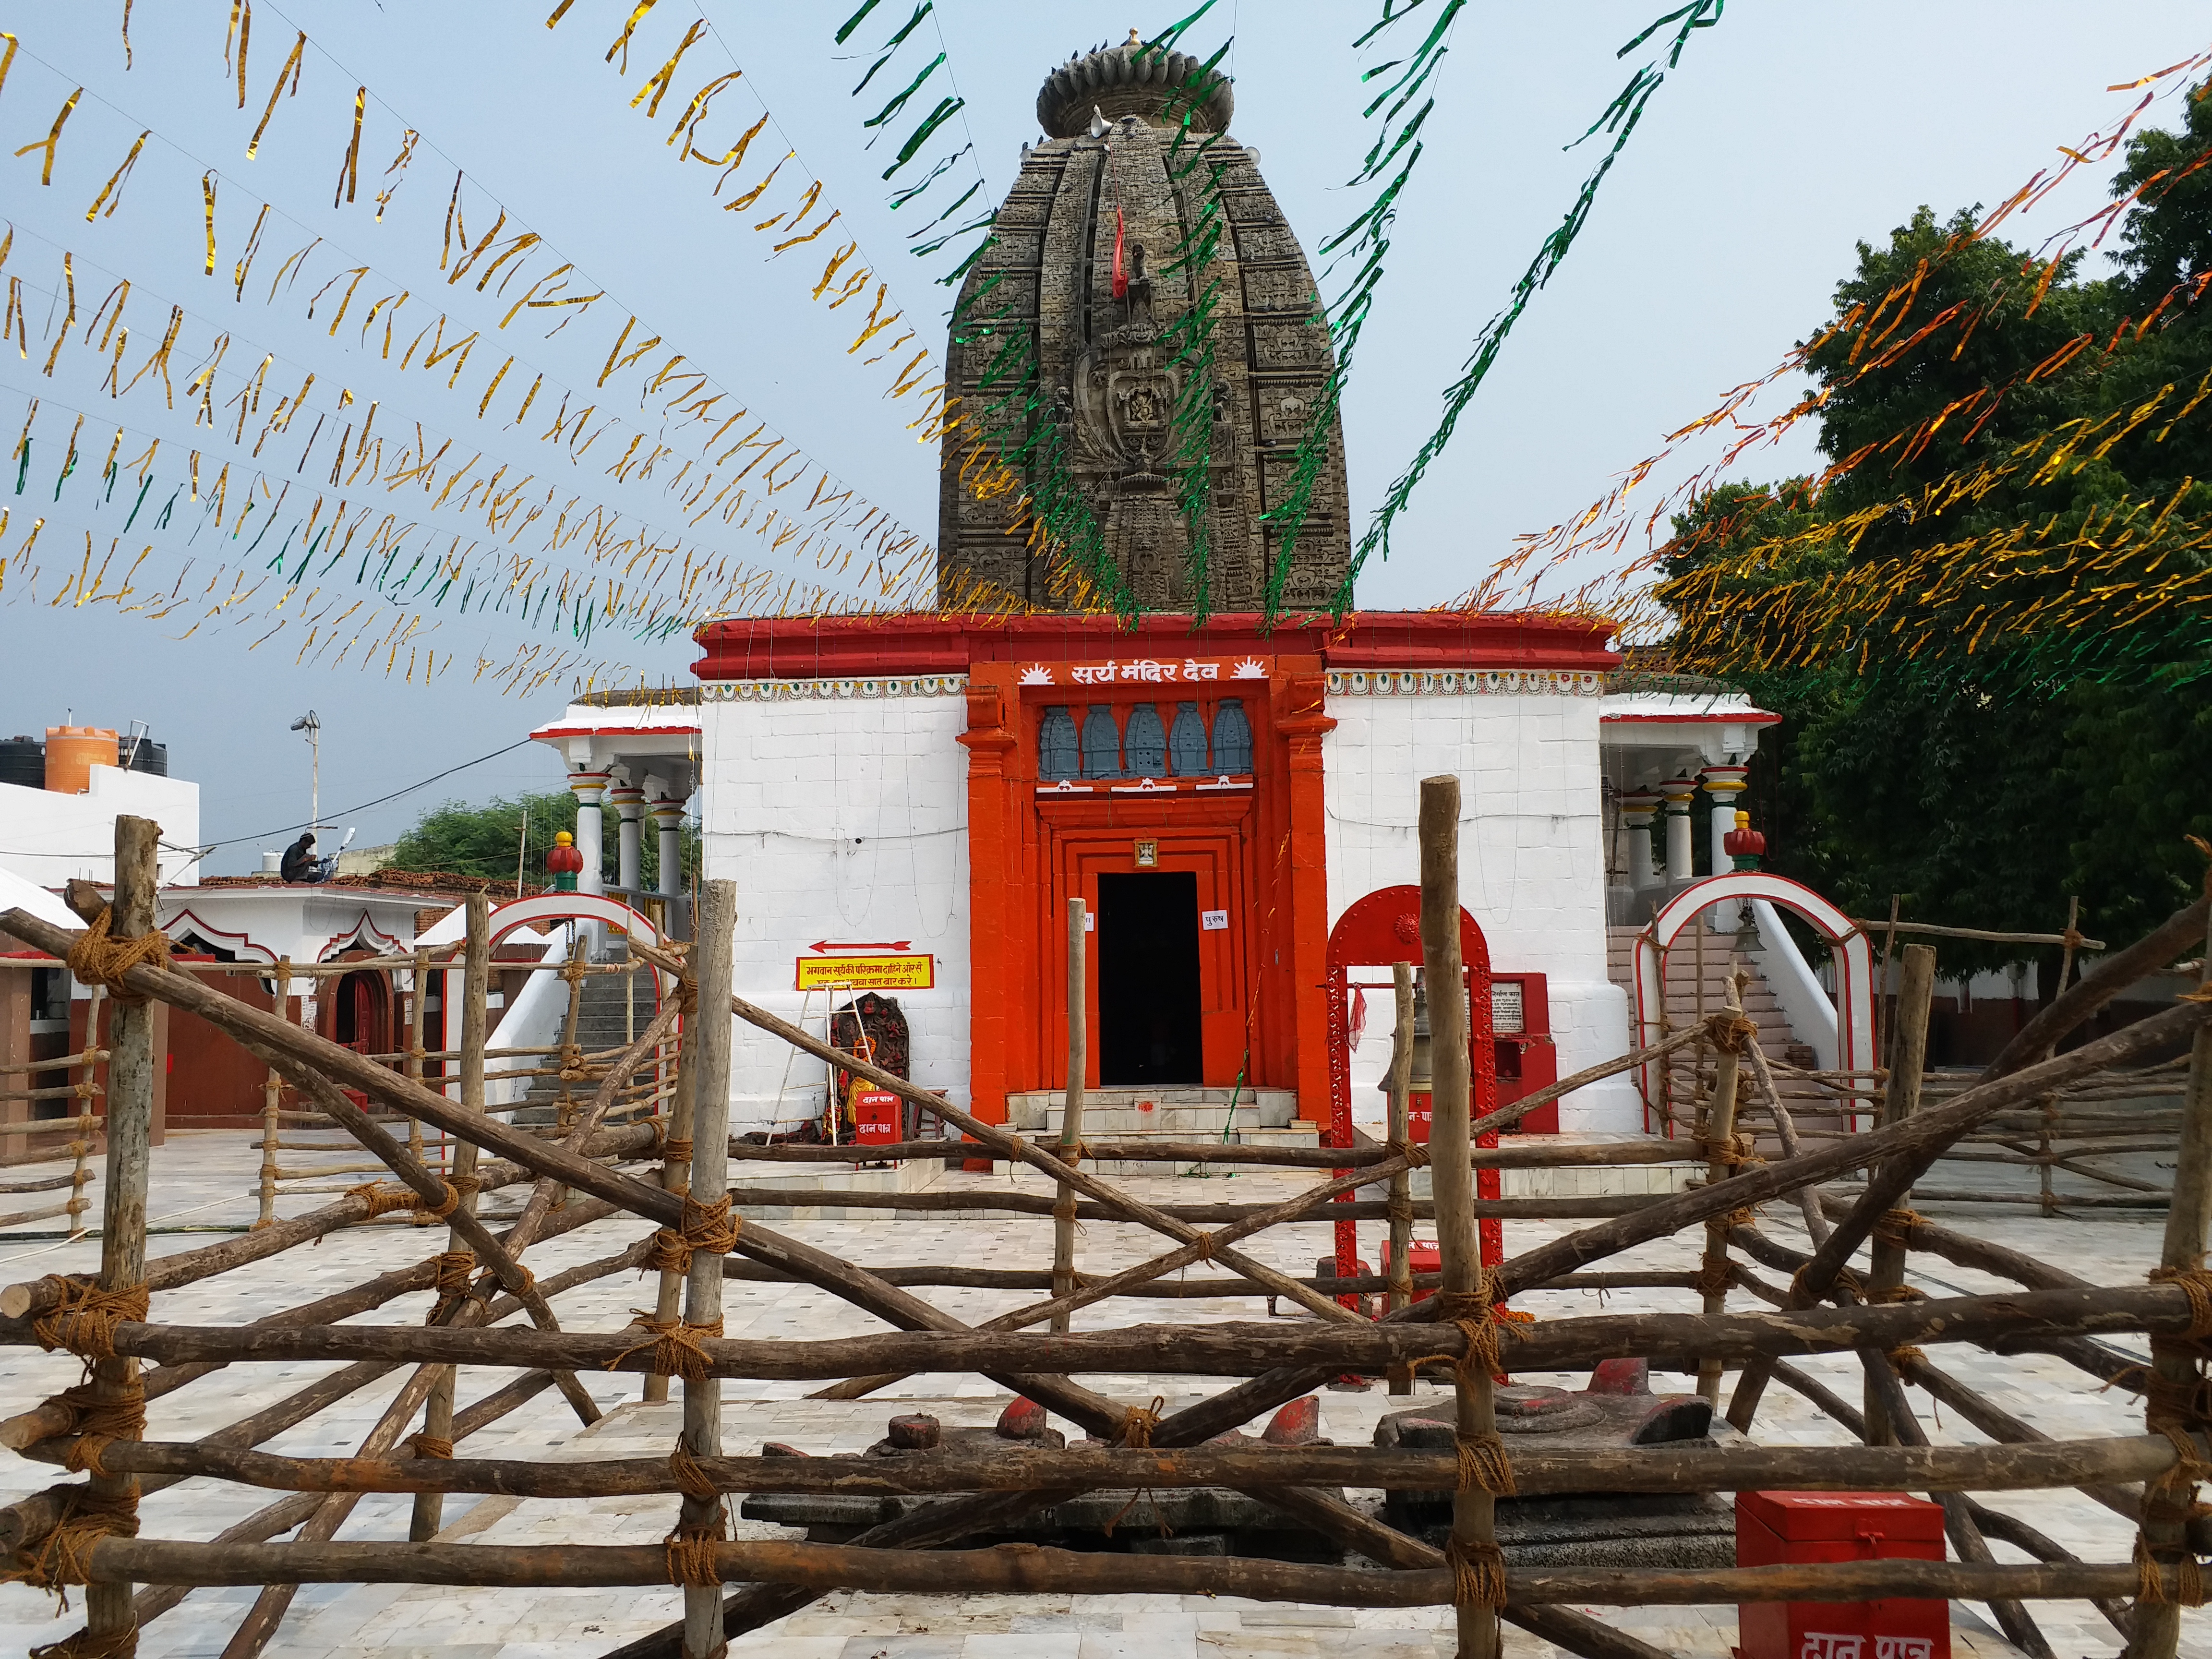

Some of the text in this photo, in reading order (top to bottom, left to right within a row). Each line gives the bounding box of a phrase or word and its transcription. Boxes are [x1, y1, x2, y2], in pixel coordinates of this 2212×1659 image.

[1071, 659, 1220, 685] सूर्य मंदिर देव
[1205, 915, 1224, 926] पुरुष
[806, 966, 833, 975] भगवान
[854, 963, 883, 976] परिक्रमा
[883, 962, 902, 975] दाहिने
[867, 978, 883, 986] सात
[862, 1096, 879, 1105] दान
[858, 1123, 892, 1137] दान पात्र
[1801, 1632, 1867, 1659] दान
